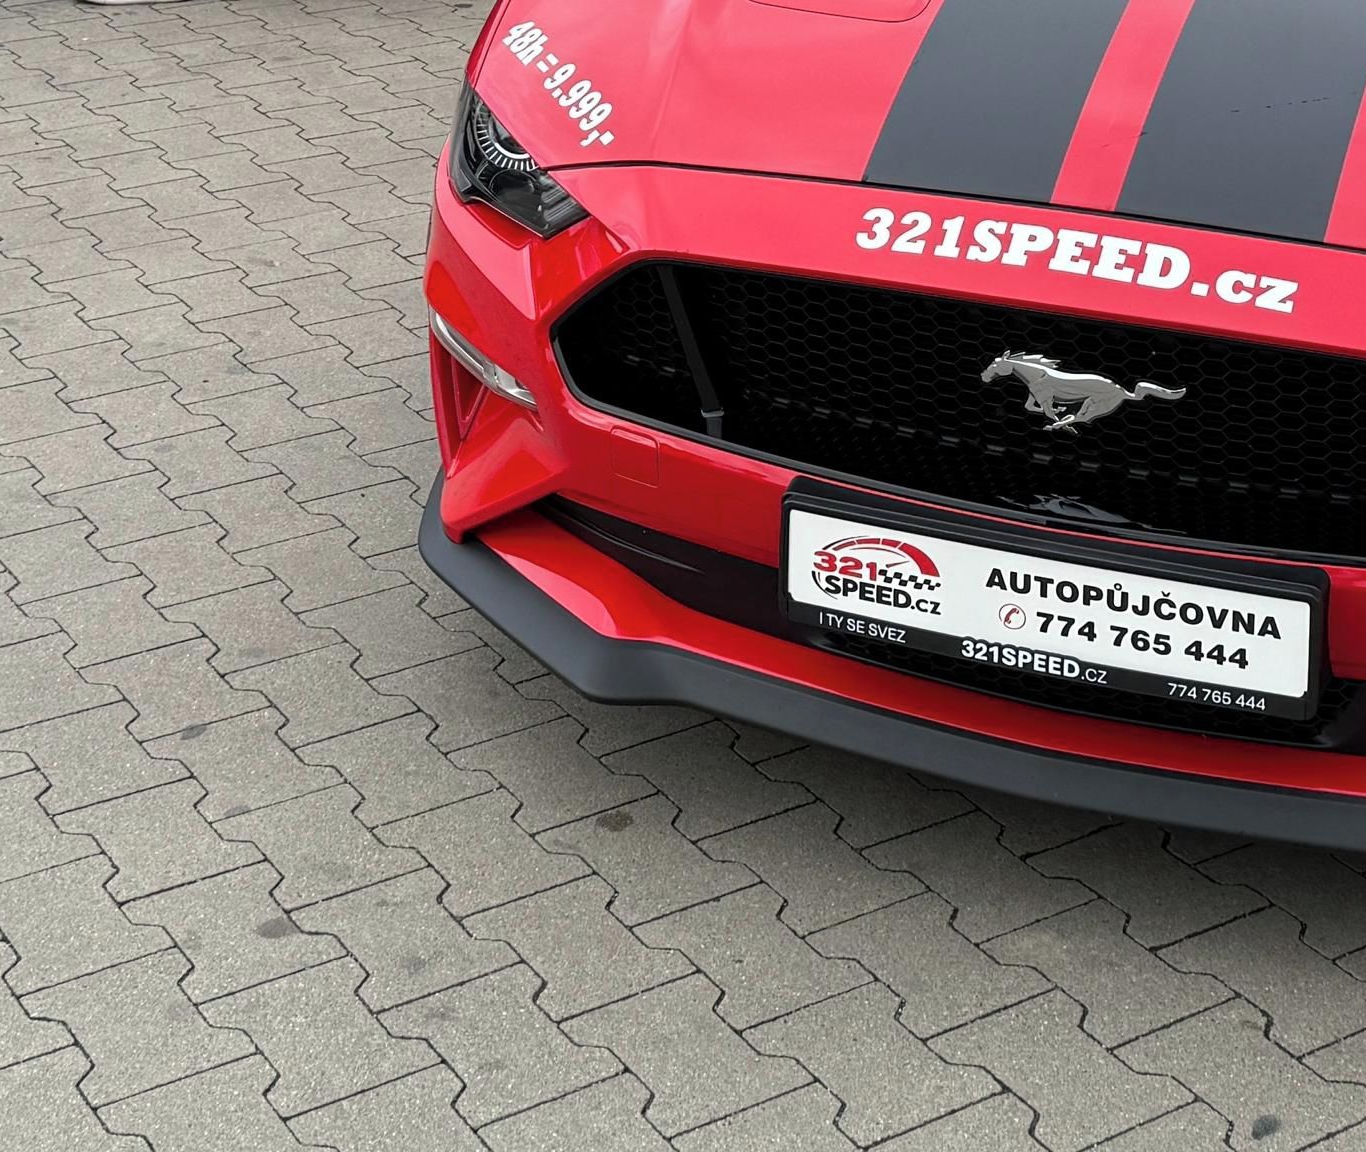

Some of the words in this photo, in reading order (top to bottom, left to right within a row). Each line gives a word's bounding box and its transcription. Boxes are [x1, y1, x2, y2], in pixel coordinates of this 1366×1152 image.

[502, 21, 549, 66] 48h
[536, 53, 559, 73] =
[543, 63, 615, 147] 9.999,-
[854, 206, 1300, 314] 321SPEED.cz
[812, 550, 878, 582] 321
[823, 575, 942, 616] SPEED.cz
[985, 567, 1282, 640] AUTOPŮJČOVNA
[818, 611, 823, 626] I
[825, 613, 844, 629] TY
[846, 617, 866, 634] SE
[868, 621, 907, 644] SVEZ
[1035, 611, 1097, 642] 774
[1109, 625, 1172, 655] 765
[1183, 641, 1249, 670] 444
[1167, 682, 1198, 701] 774
[1201, 688, 1232, 707] 765
[1235, 693, 1266, 712] 444
